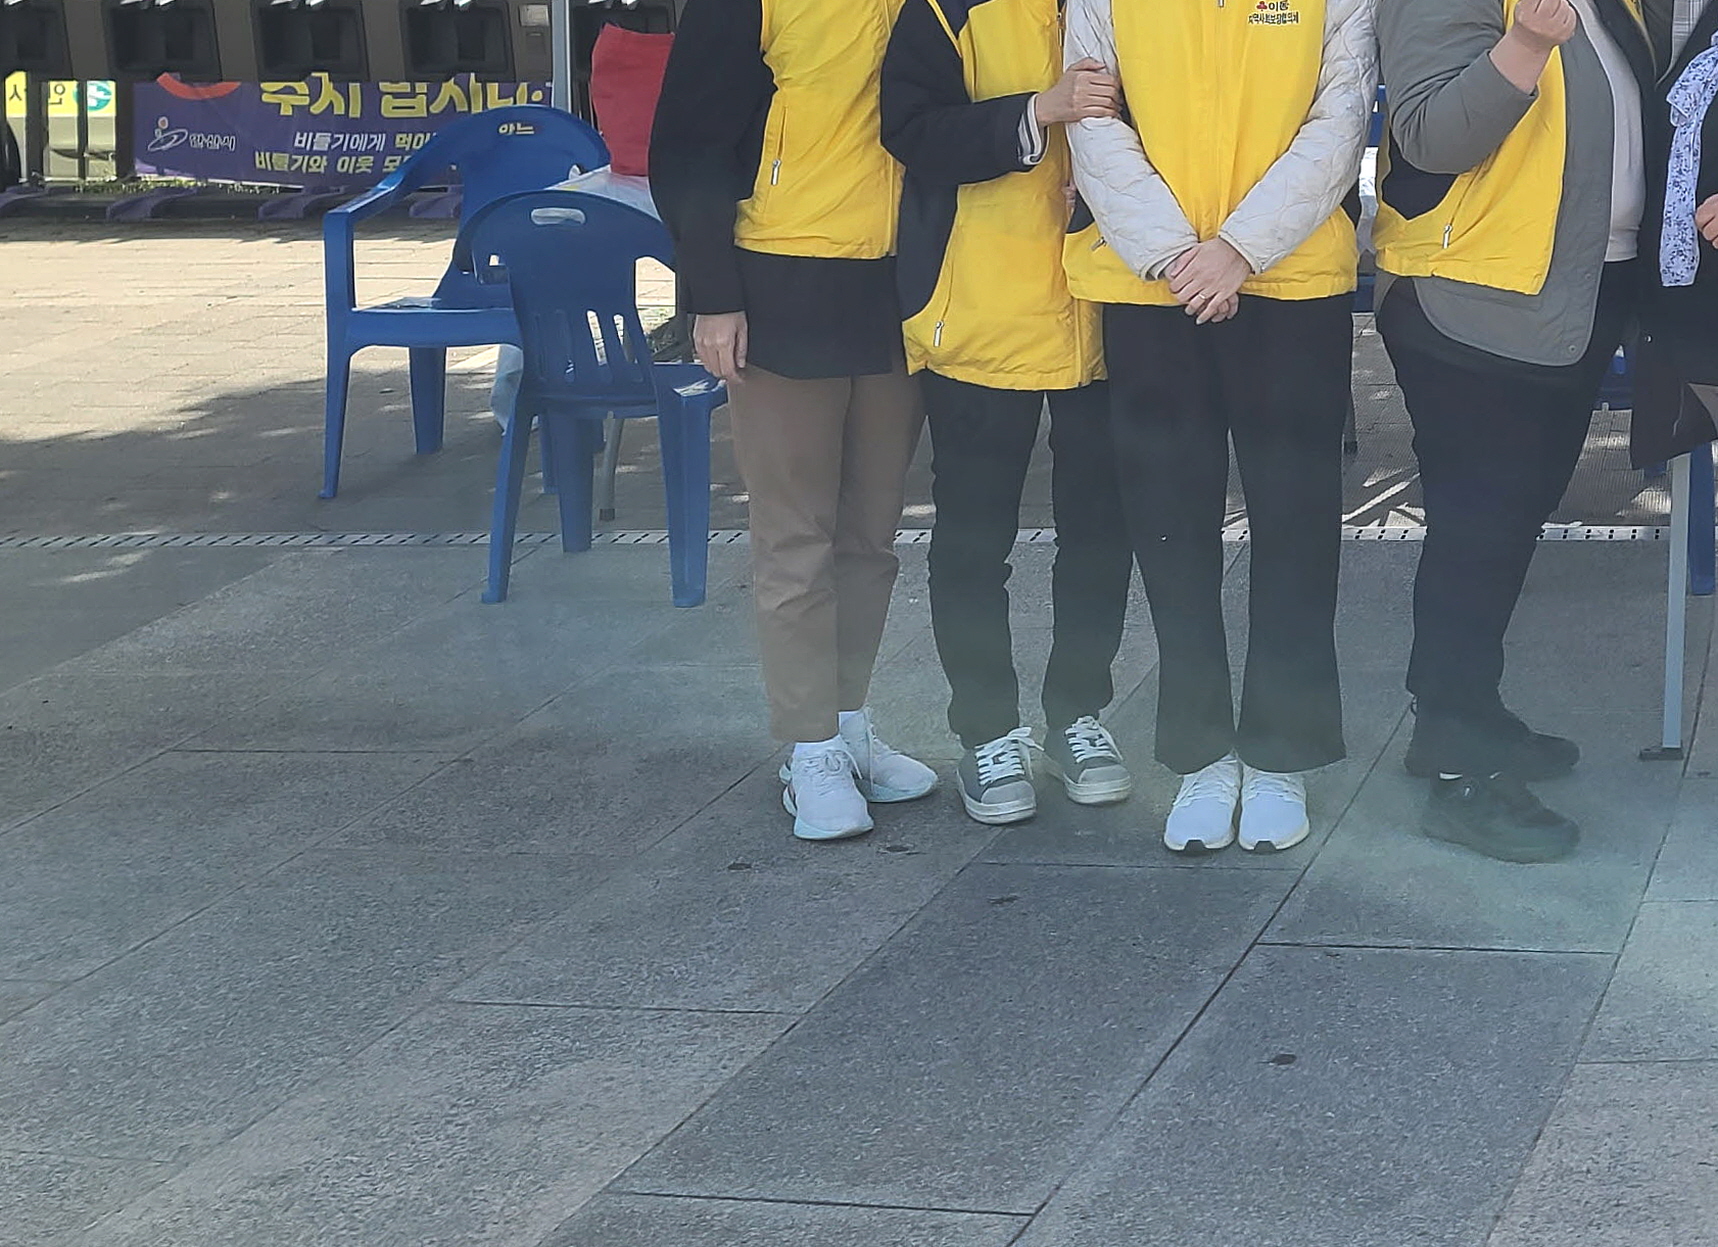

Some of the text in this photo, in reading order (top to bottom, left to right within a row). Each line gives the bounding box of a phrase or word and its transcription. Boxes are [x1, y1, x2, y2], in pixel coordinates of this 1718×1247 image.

[293, 132, 437, 152] 비둘기에게 먹이
[254, 151, 328, 174] 비둘기와
[336, 155, 375, 174] 이웃
